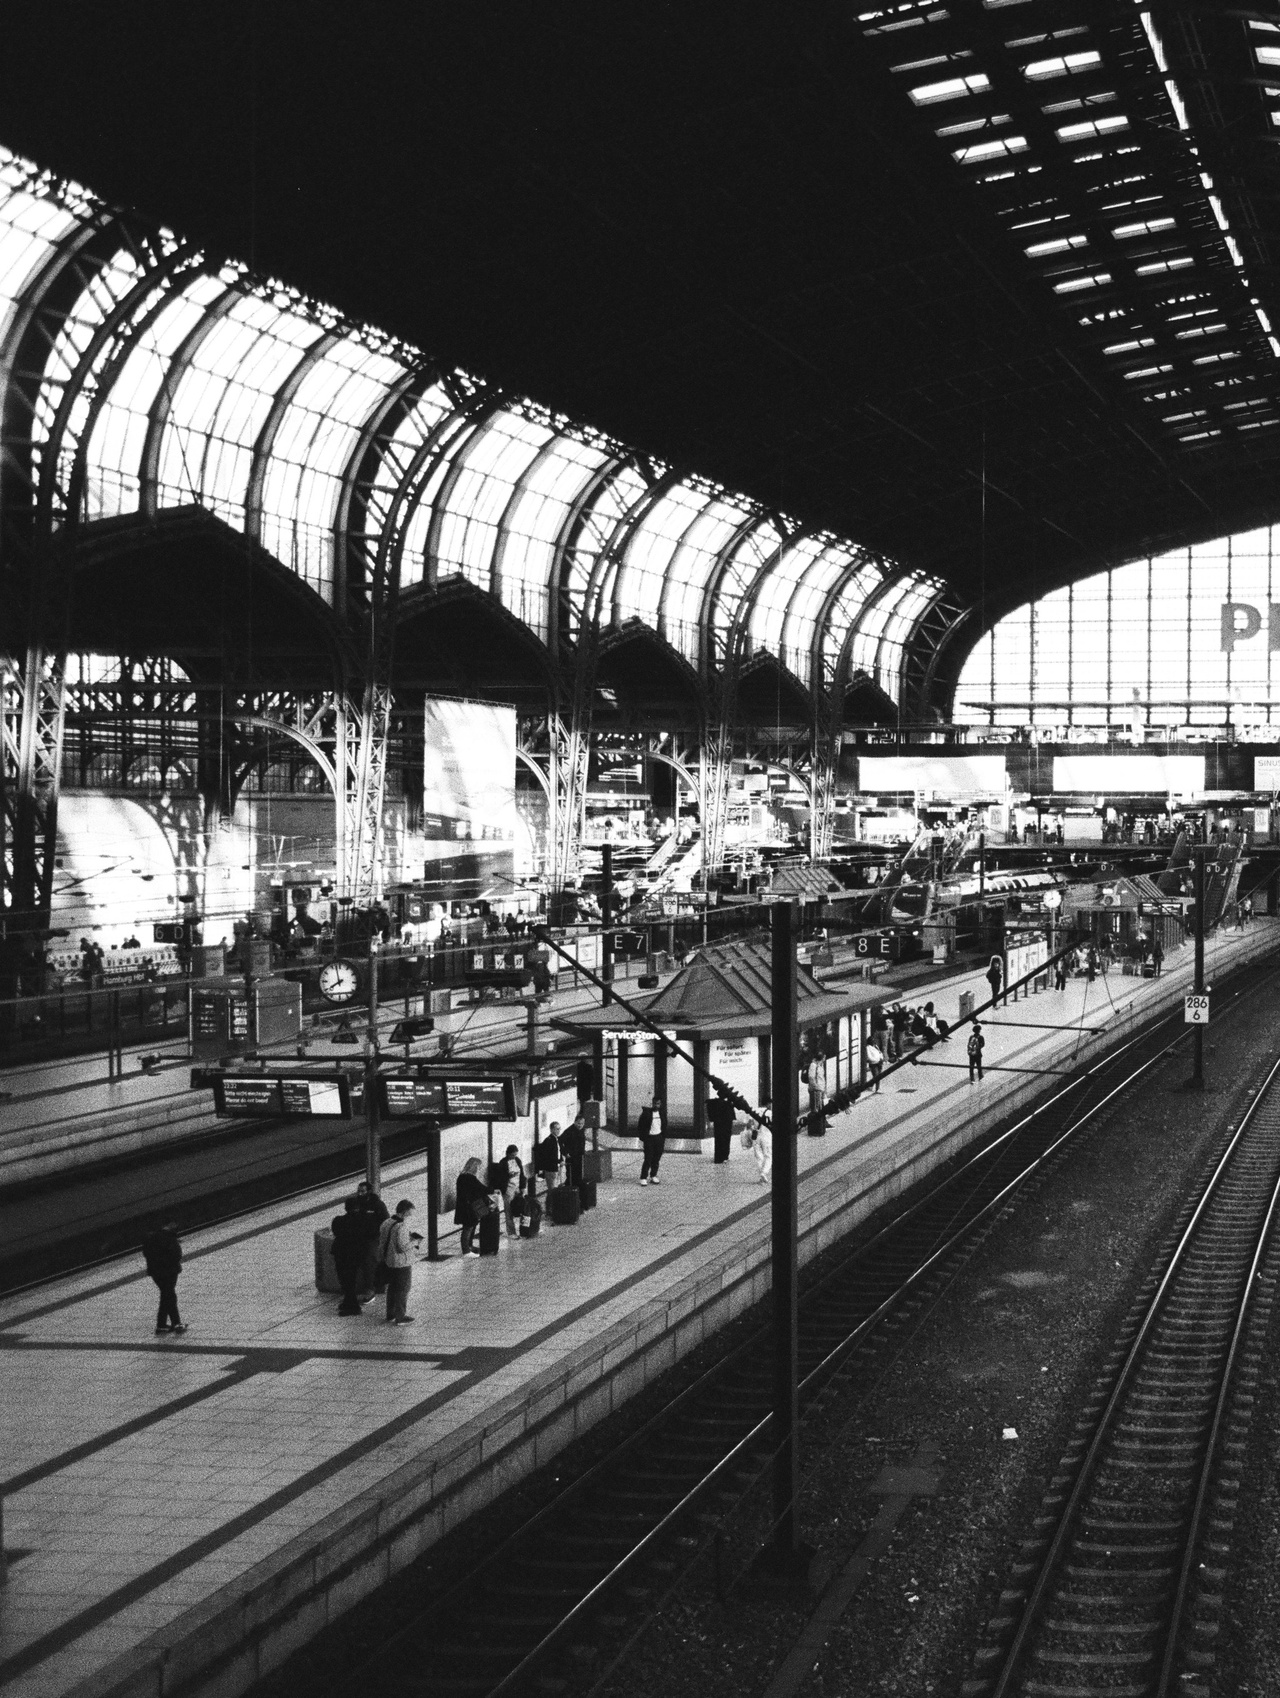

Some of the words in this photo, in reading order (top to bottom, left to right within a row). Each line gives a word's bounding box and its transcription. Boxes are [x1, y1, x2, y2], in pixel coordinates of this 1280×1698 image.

[155, 926, 164, 940] 6
[174, 926, 184, 940] D
[614, 934, 623, 949] E
[635, 935, 644, 949] 7
[858, 938, 868, 953] 8
[880, 938, 890, 953] E
[103, 976, 132, 985] Hamburg
[1186, 997, 1208, 1009] 286
[1193, 1009, 1201, 1021] 6
